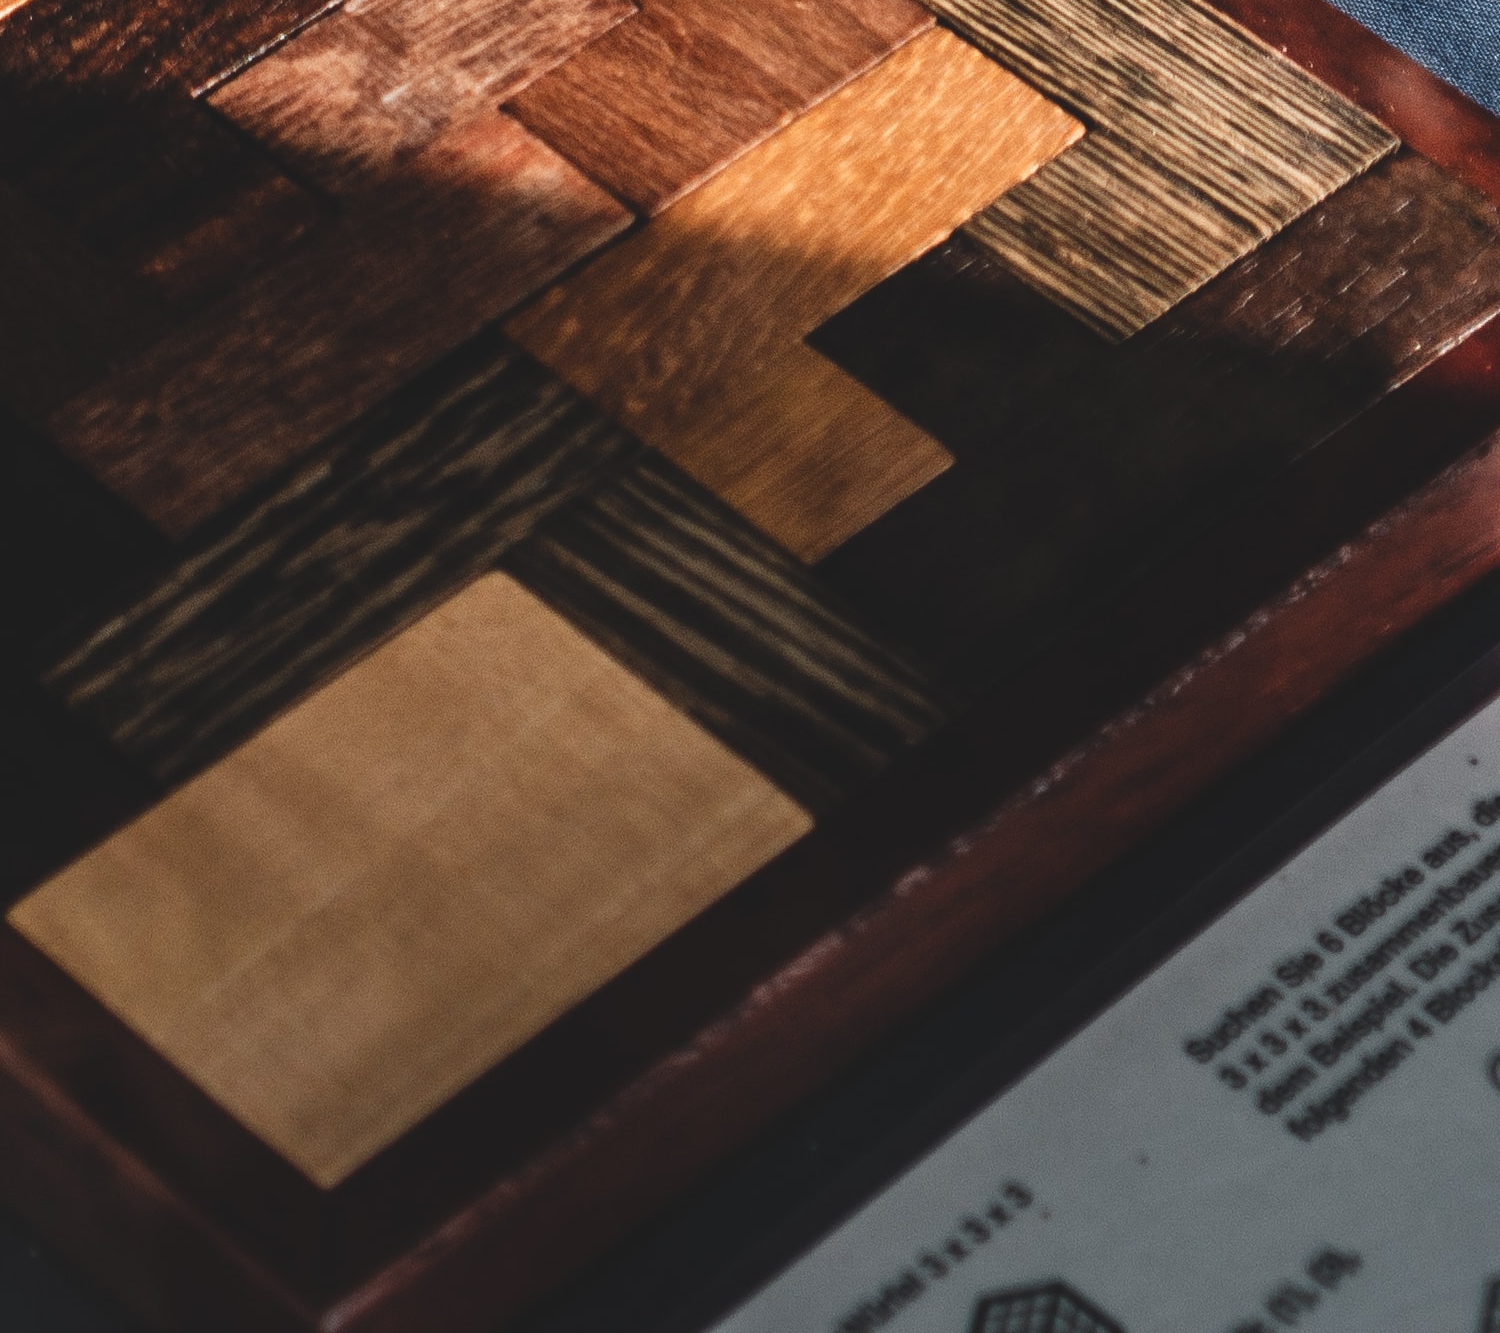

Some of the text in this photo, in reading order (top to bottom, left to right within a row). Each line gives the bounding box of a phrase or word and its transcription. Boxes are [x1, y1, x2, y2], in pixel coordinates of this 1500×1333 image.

[1272, 949, 1324, 988] Sie
[1314, 929, 1344, 953] 6
[1333, 865, 1425, 937] Blöcke
[1216, 1064, 1248, 1091] 3
[1243, 1051, 1269, 1073] x
[1258, 1030, 1288, 1056] 3
[1283, 1016, 1309, 1039] x
[1299, 995, 1330, 1021] 3
[1255, 1062, 1318, 1115] dem
[1406, 941, 1459, 982] Die
[1406, 1016, 1433, 1038] 4
